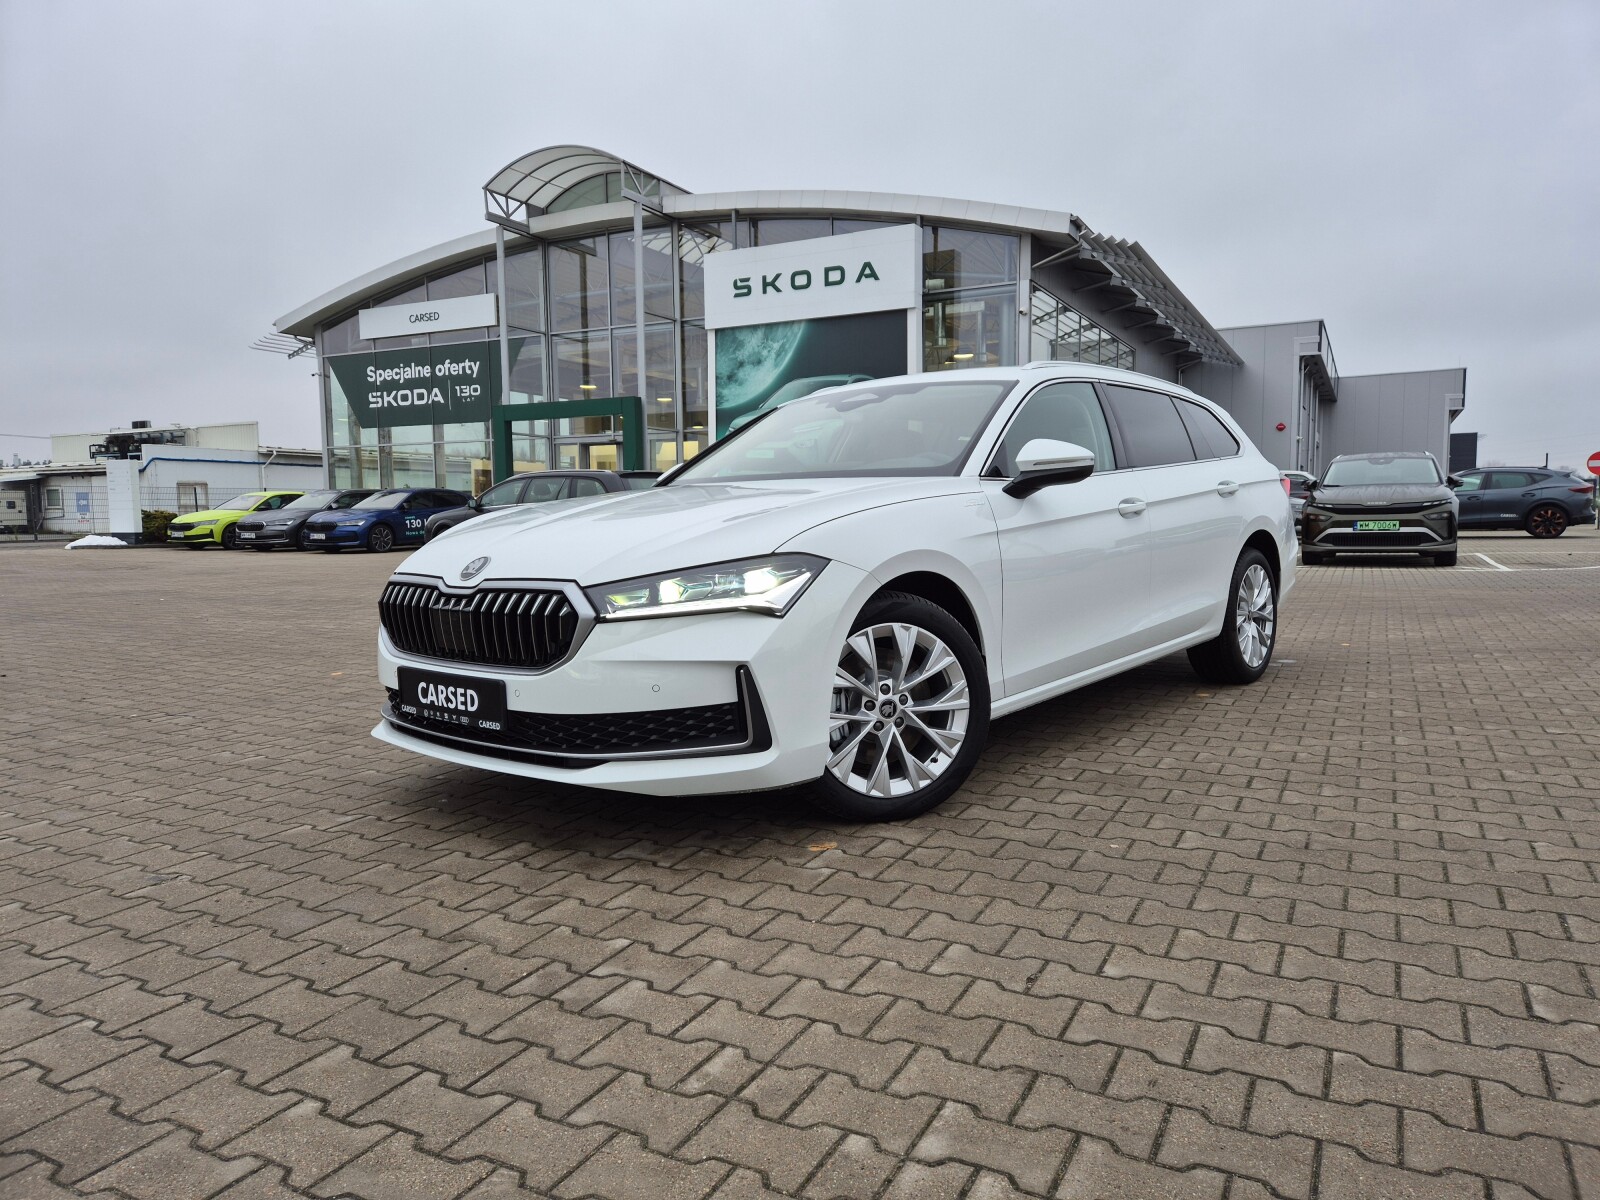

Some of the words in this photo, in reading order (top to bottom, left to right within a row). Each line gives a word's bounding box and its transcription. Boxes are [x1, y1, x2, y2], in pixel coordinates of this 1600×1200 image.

[409, 311, 440, 323] CARSED
[366, 362, 431, 385] Specjalne
[435, 358, 480, 378] oferty
[455, 384, 481, 397] 130
[405, 518, 422, 529] 130
[1359, 521, 1370, 529] WM
[417, 681, 479, 712] CARSED
[401, 704, 417, 714] CARSED
[478, 719, 500, 731] CARSED
